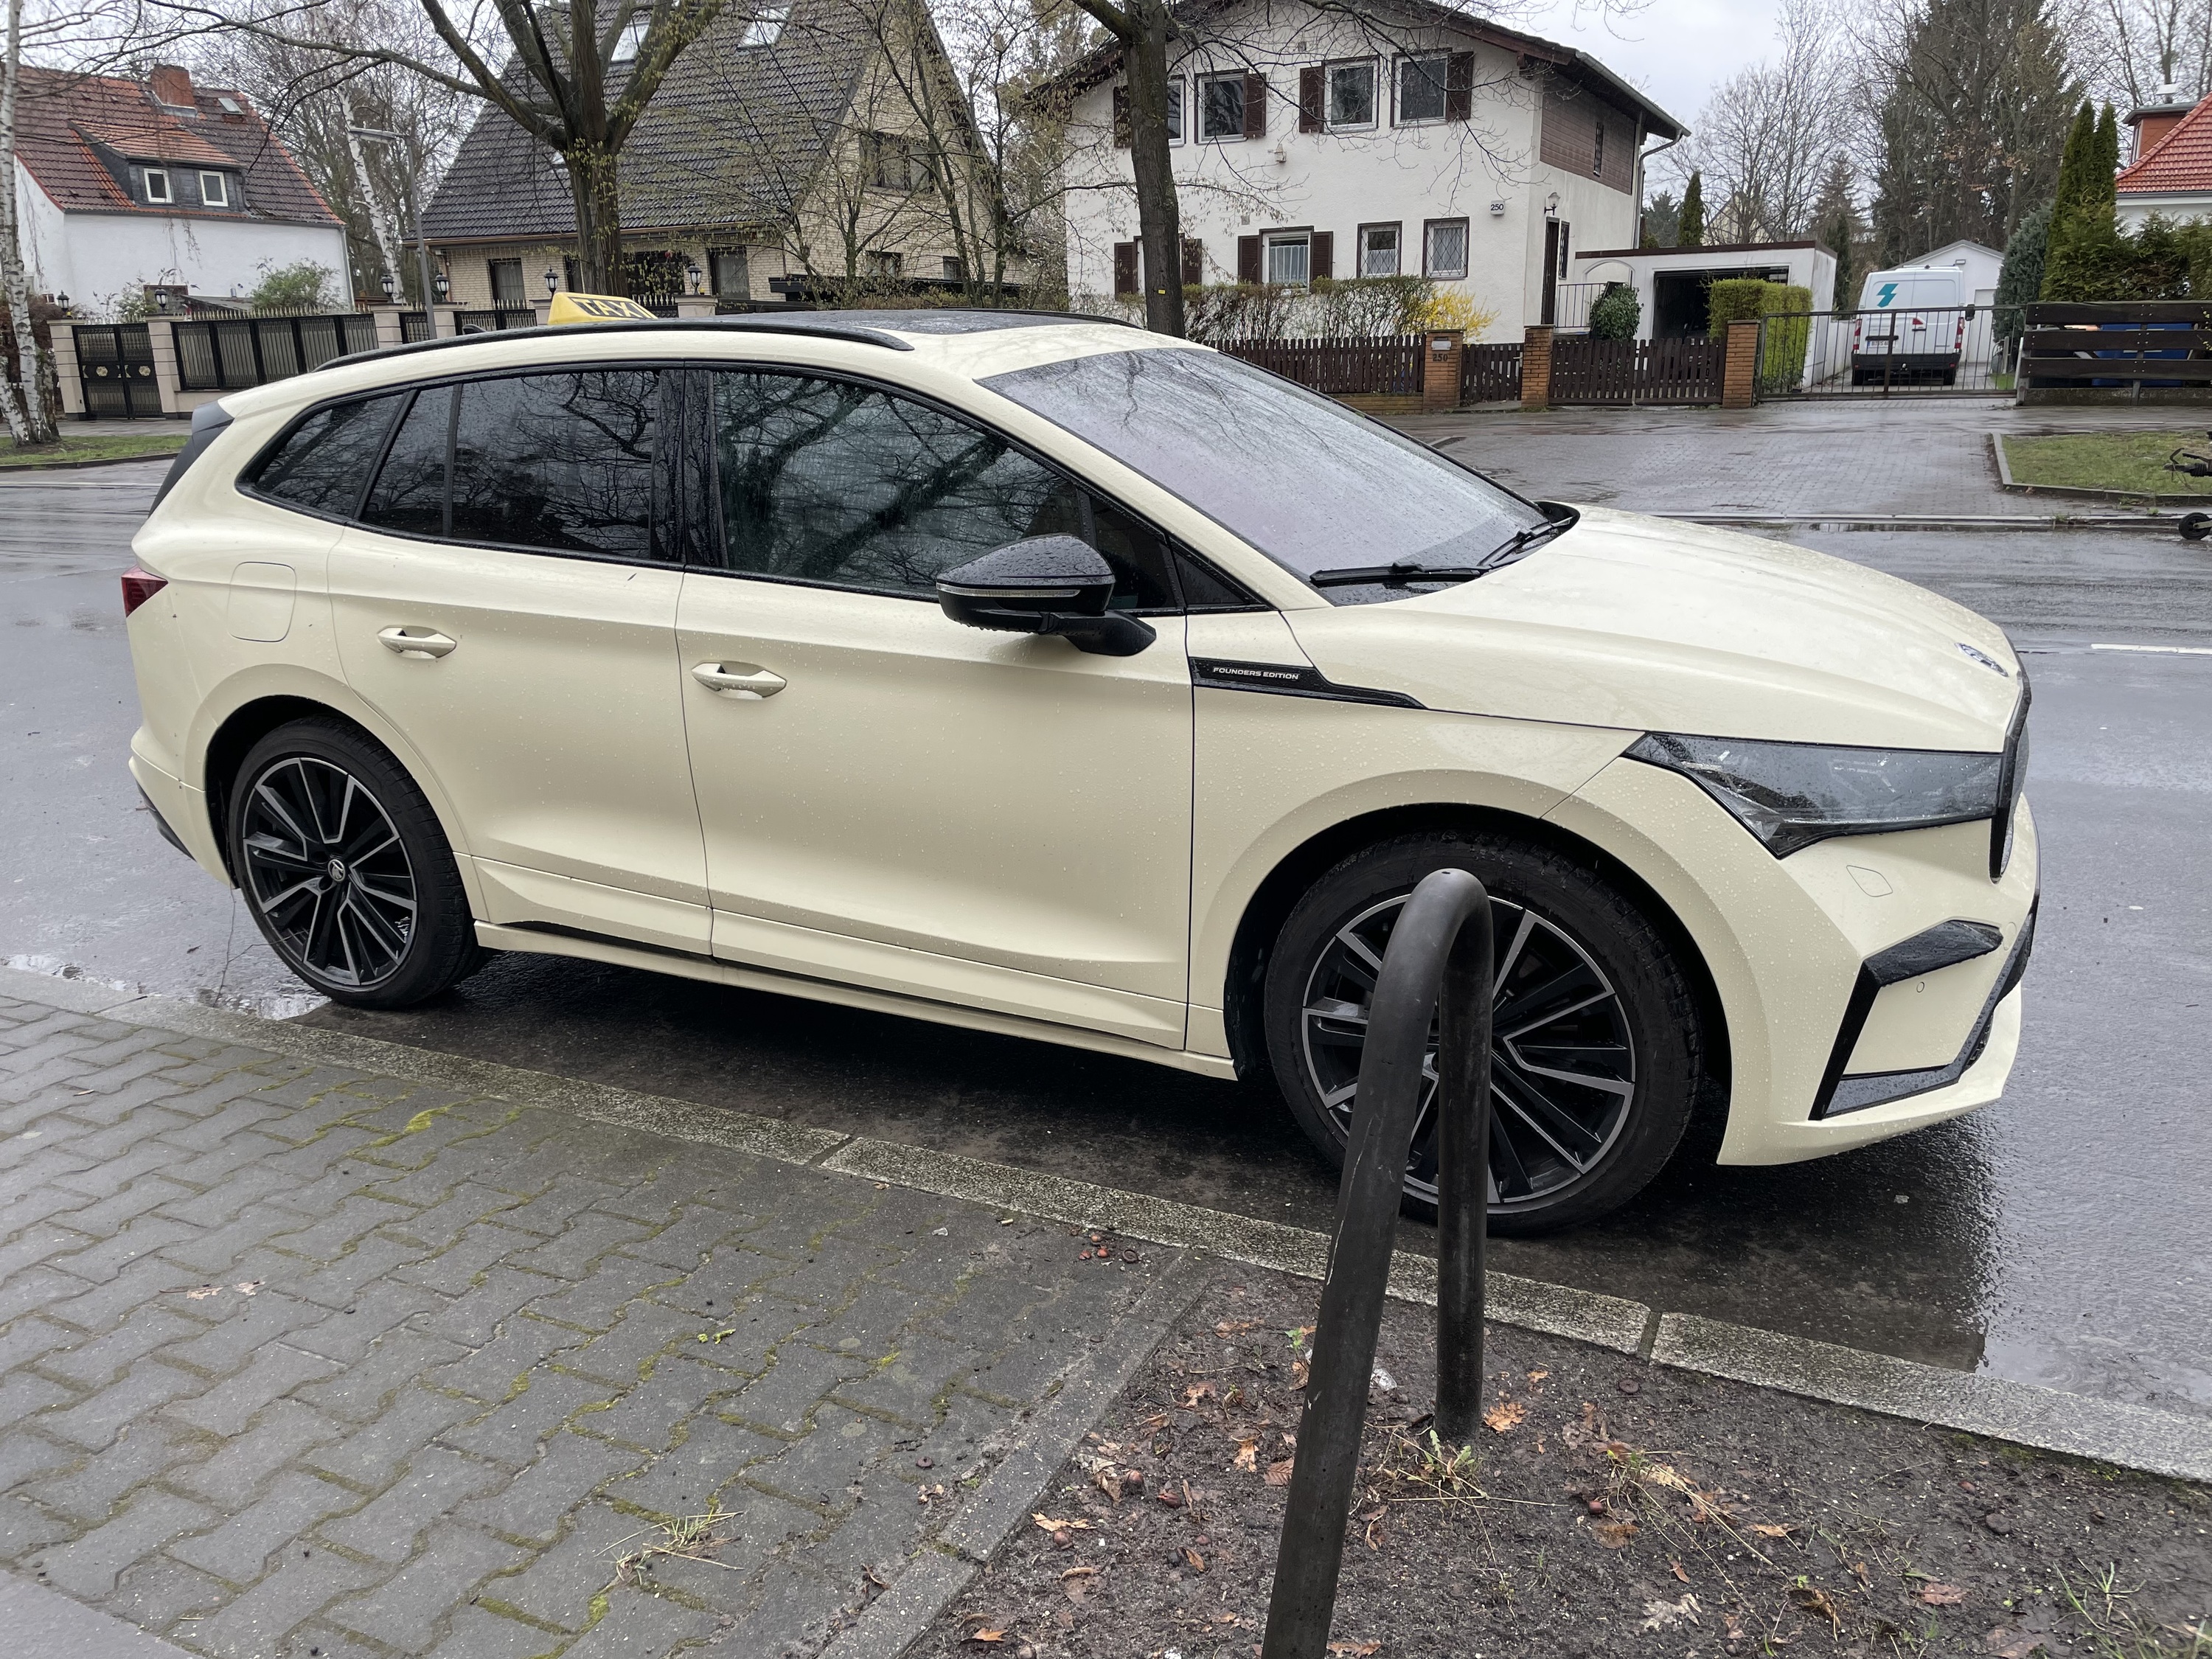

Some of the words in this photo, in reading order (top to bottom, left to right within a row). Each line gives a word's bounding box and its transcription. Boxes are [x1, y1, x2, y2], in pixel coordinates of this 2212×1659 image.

[571, 298, 651, 319] TAXI
[1213, 667, 1262, 677] FOUNDERS
[1262, 672, 1298, 680] EDITION
